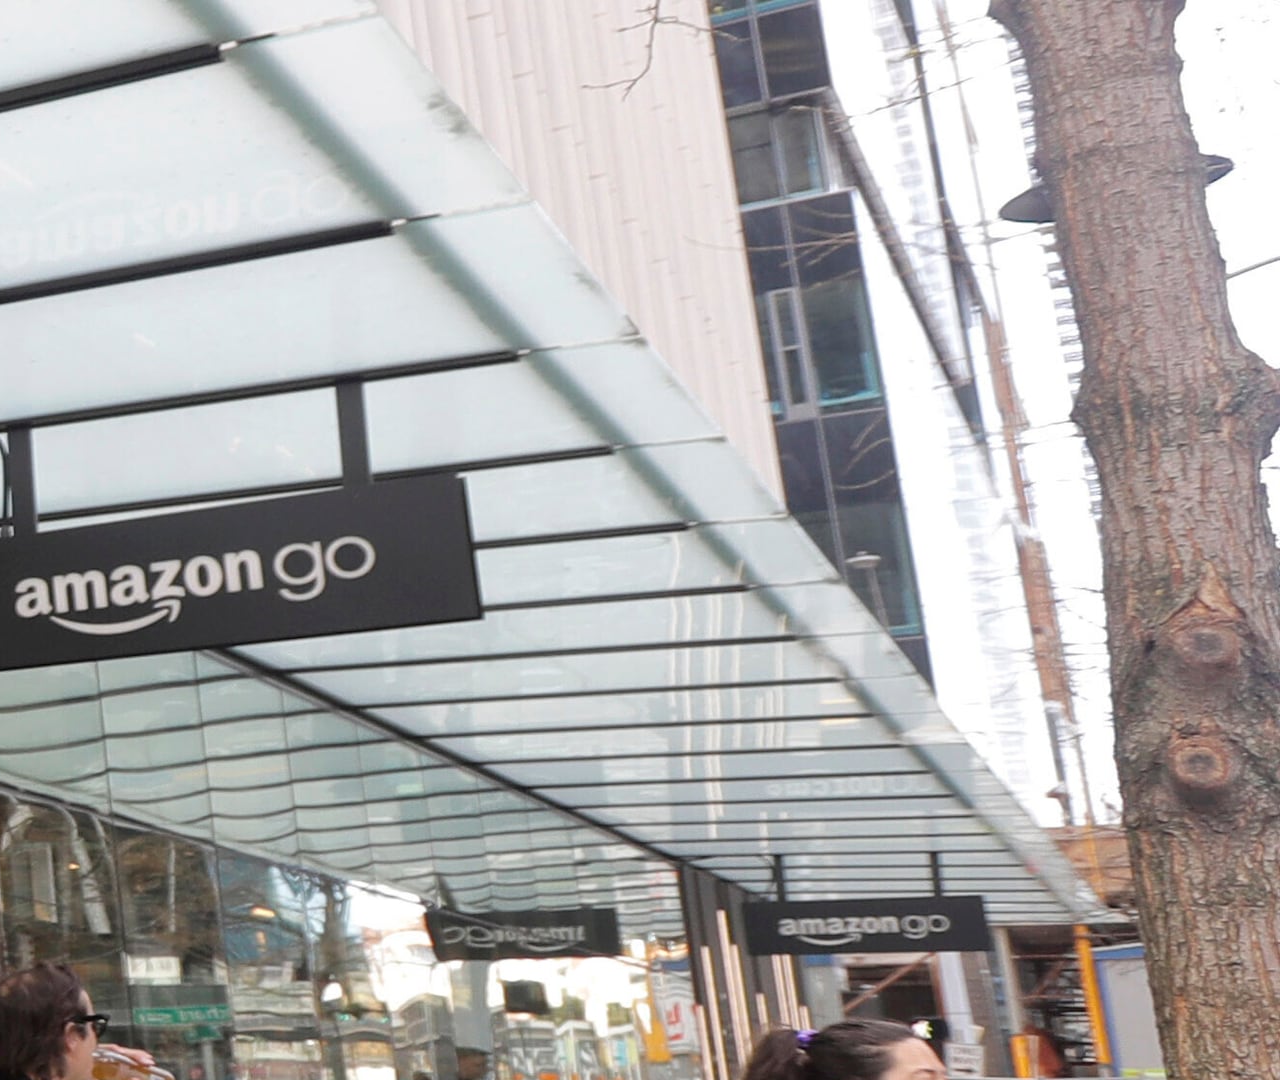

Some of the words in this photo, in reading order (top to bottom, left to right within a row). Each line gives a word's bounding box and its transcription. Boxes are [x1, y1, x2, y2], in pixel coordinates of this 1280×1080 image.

[14, 549, 264, 618] amazon
[273, 535, 376, 601] go
[777, 915, 900, 936] amazon
[901, 914, 951, 940] go
